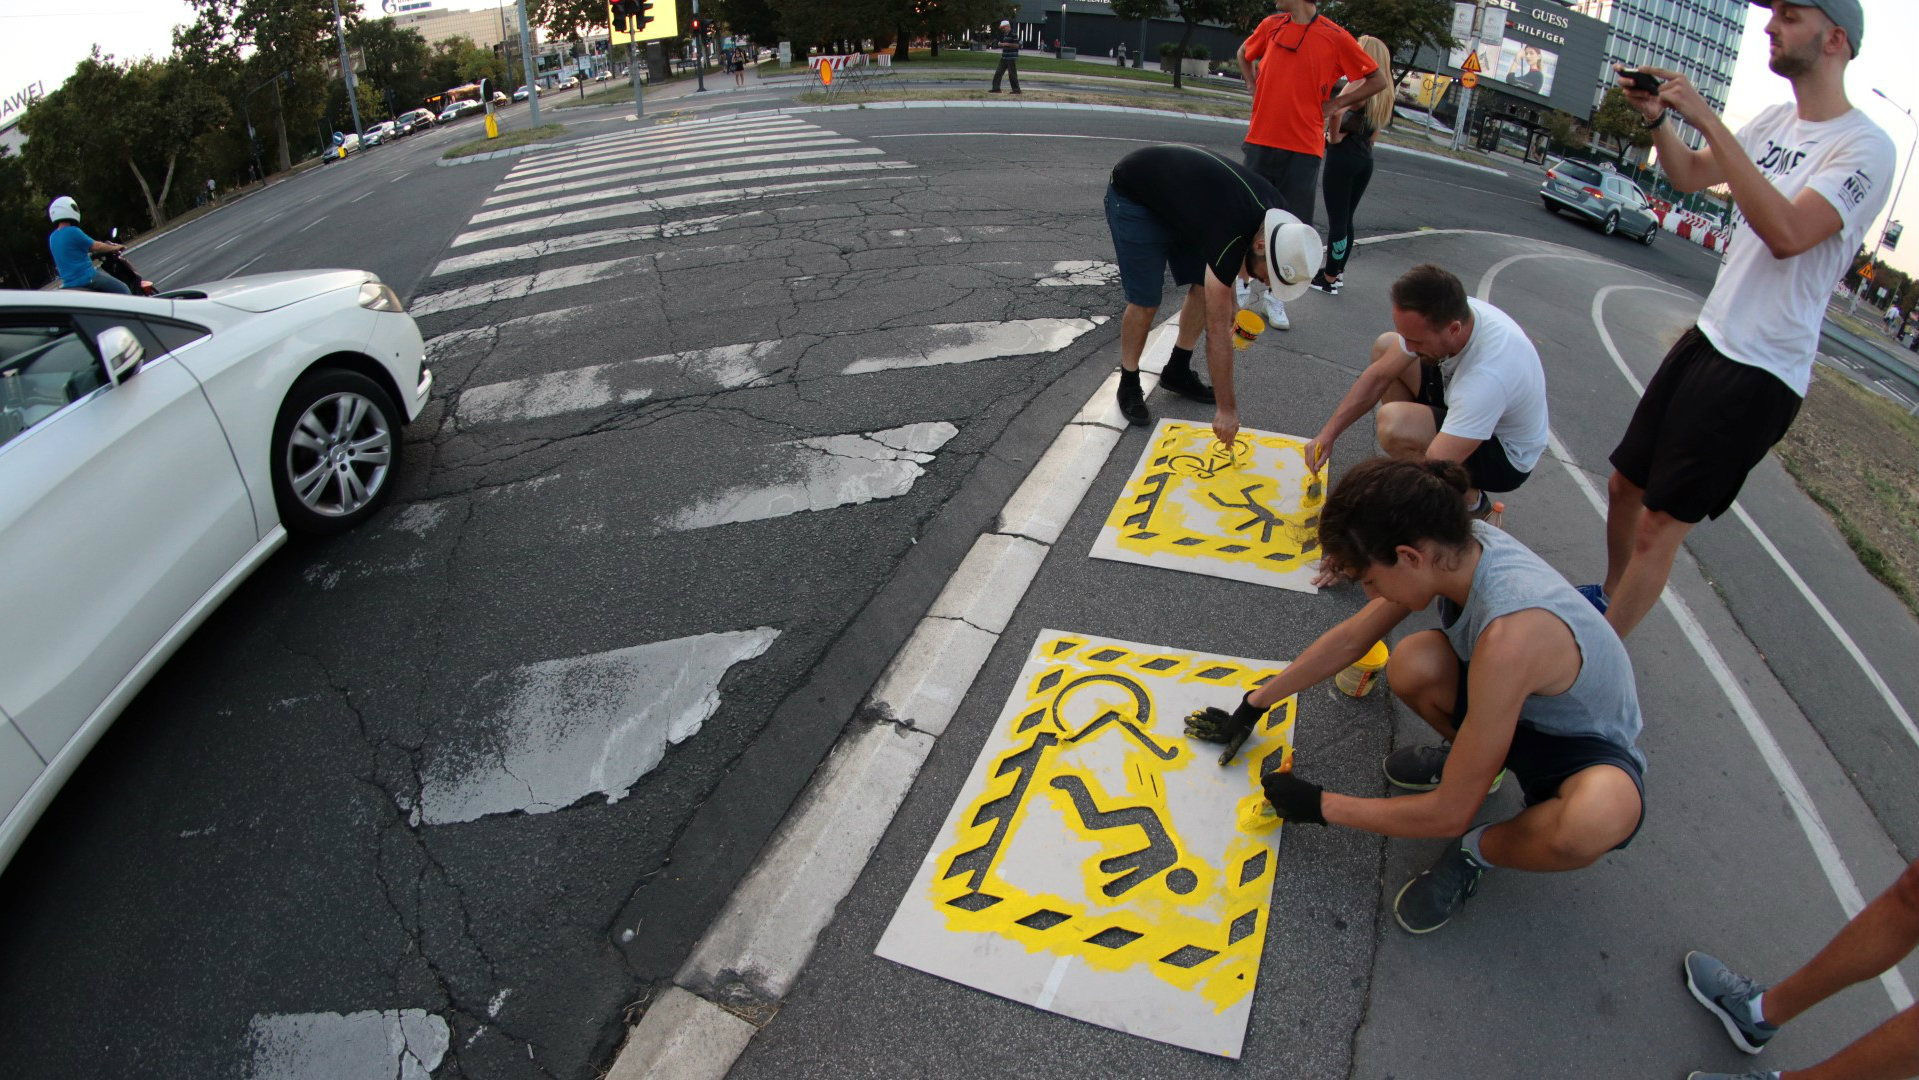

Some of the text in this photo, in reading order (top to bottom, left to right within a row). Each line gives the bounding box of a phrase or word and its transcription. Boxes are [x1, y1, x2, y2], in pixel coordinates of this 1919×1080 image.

[1532, 8, 1569, 29] GUESS
[1517, 23, 1565, 46] HILFIGER
[0, 80, 45, 118] AWEI
[1843, 176, 1864, 204] NRC
